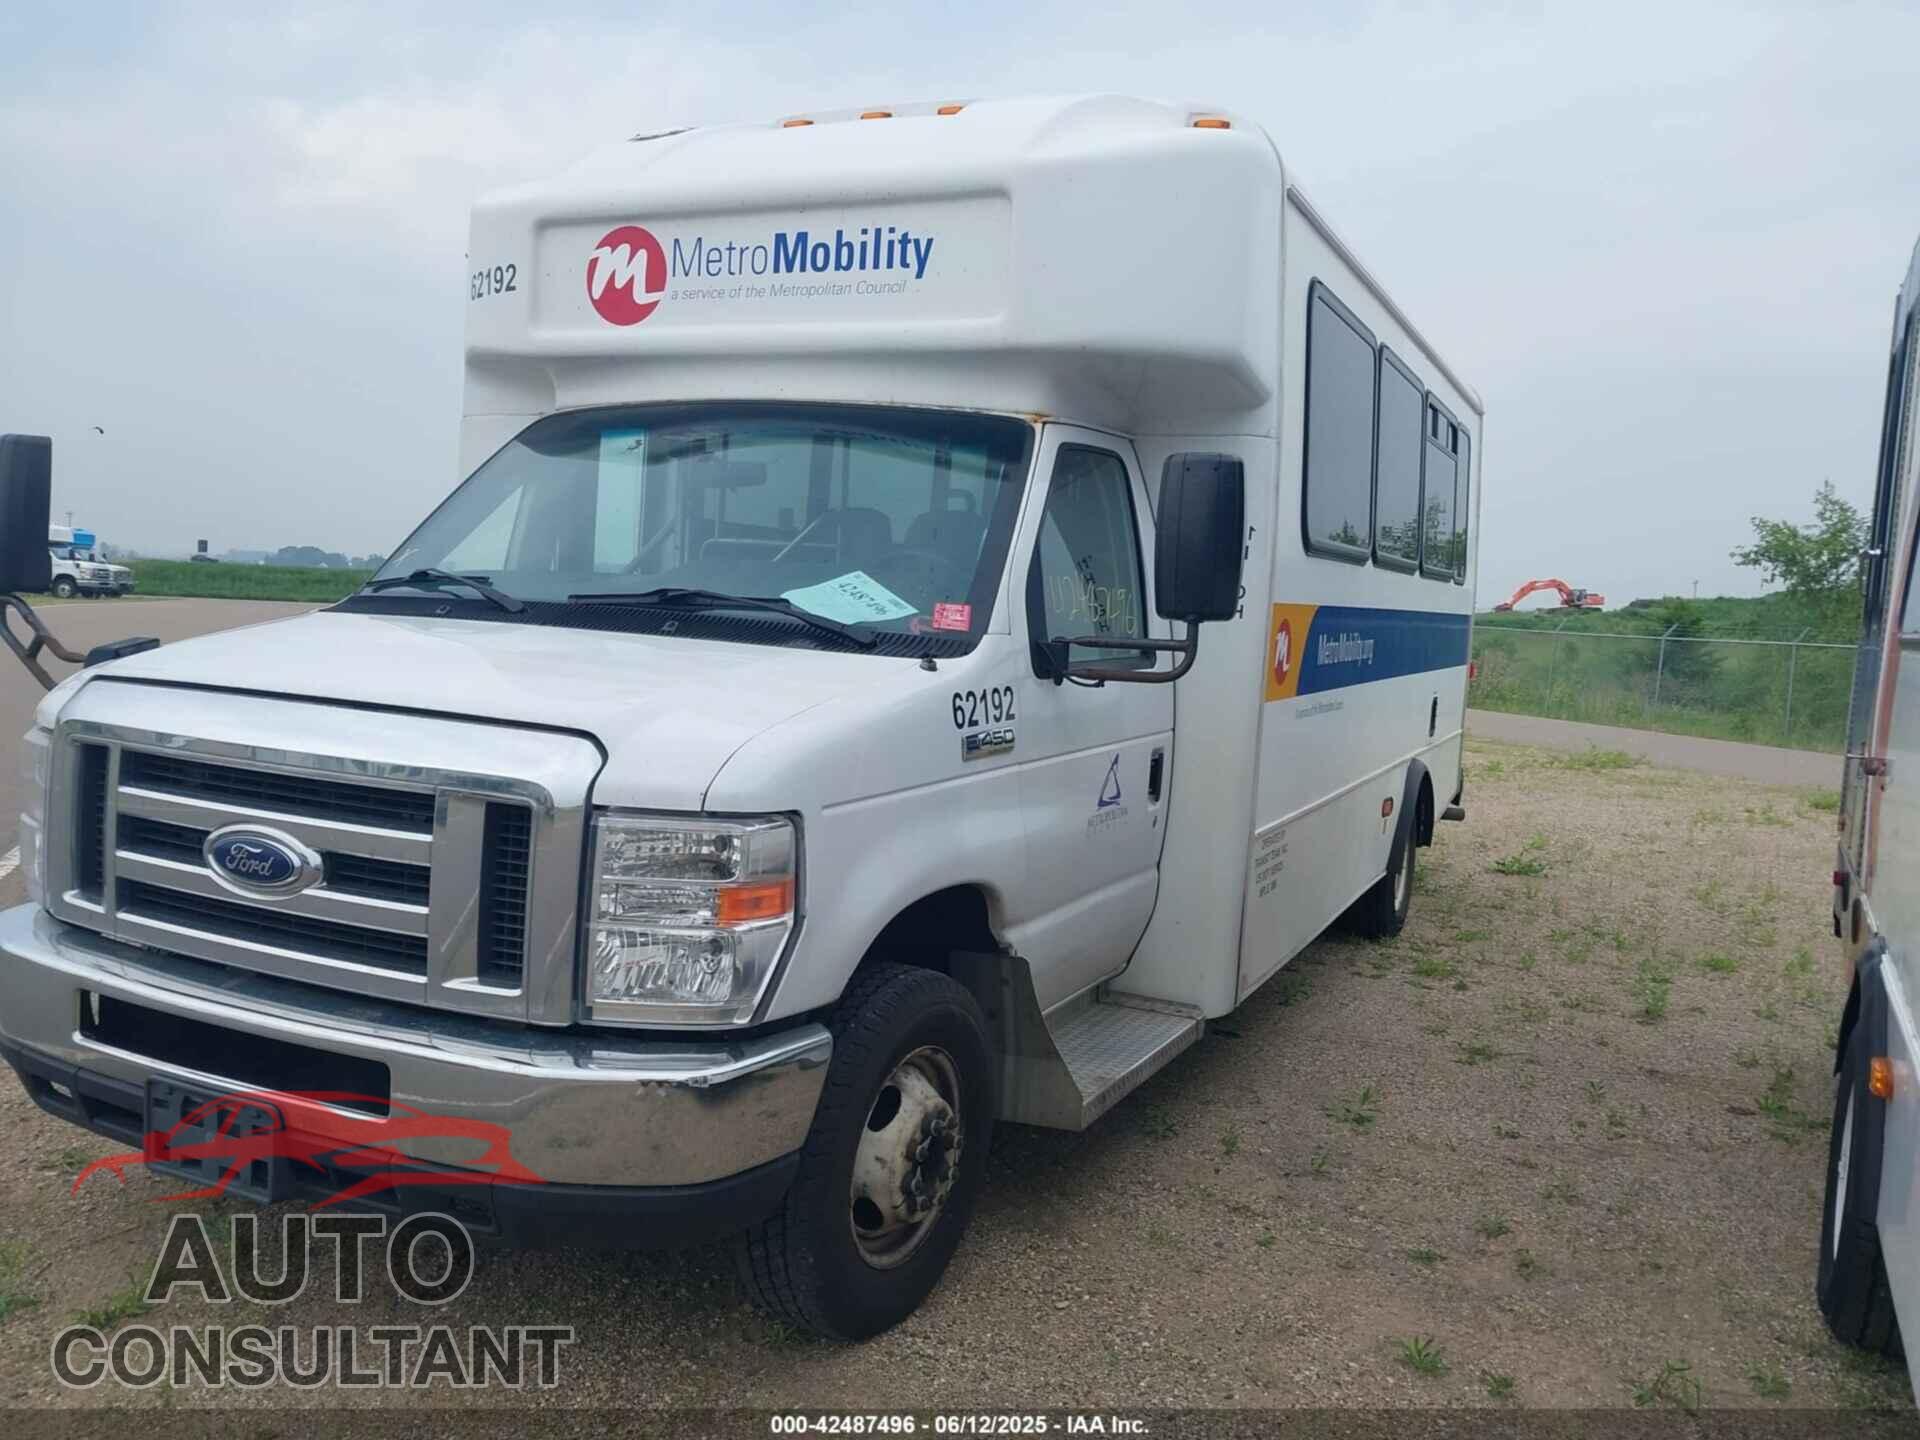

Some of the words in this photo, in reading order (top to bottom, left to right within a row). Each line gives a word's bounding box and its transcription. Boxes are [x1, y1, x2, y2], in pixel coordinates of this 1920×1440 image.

[671, 226, 934, 279] MetroMobility
[471, 263, 517, 301] 62192
[671, 289, 679, 300] a
[682, 287, 725, 300] service
[728, 285, 744, 299] of
[745, 285, 766, 298] the
[769, 282, 851, 300] Metropolitan
[855, 279, 907, 296] Council
[952, 686, 1016, 729] 62192
[224, 842, 275, 876] Ford
